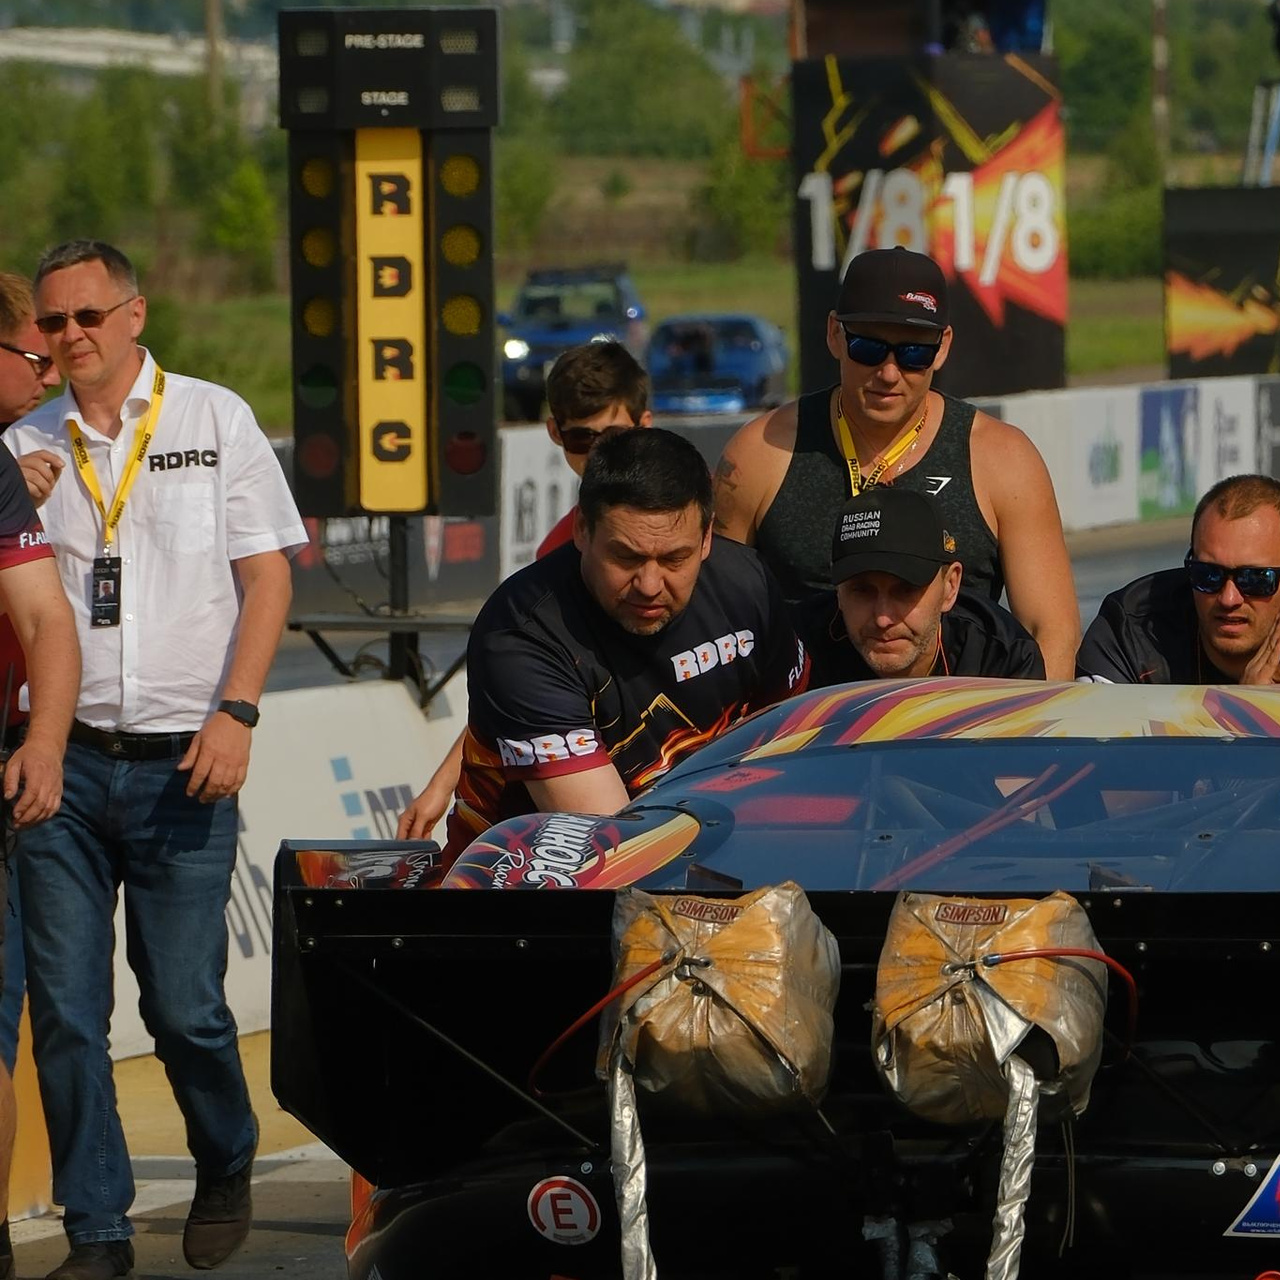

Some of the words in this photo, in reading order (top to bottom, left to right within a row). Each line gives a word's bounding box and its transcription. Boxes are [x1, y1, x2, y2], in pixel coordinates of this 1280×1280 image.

[344, 34, 425, 49] PRE-STAGE
[360, 91, 410, 106] STAGE
[798, 167, 930, 285] 1/8
[941, 170, 1060, 287] 1/8
[148, 449, 219, 472] RDRC
[841, 523, 856, 533] DRAG
[855, 520, 881, 529] RACING
[843, 510, 881, 524] RUSSIAN
[840, 528, 881, 541] COMMUNITY
[670, 629, 755, 683] RDRC
[678, 900, 740, 921] SIMPSON
[940, 905, 1001, 922] SIMPSON
[549, 1193, 578, 1229] E
